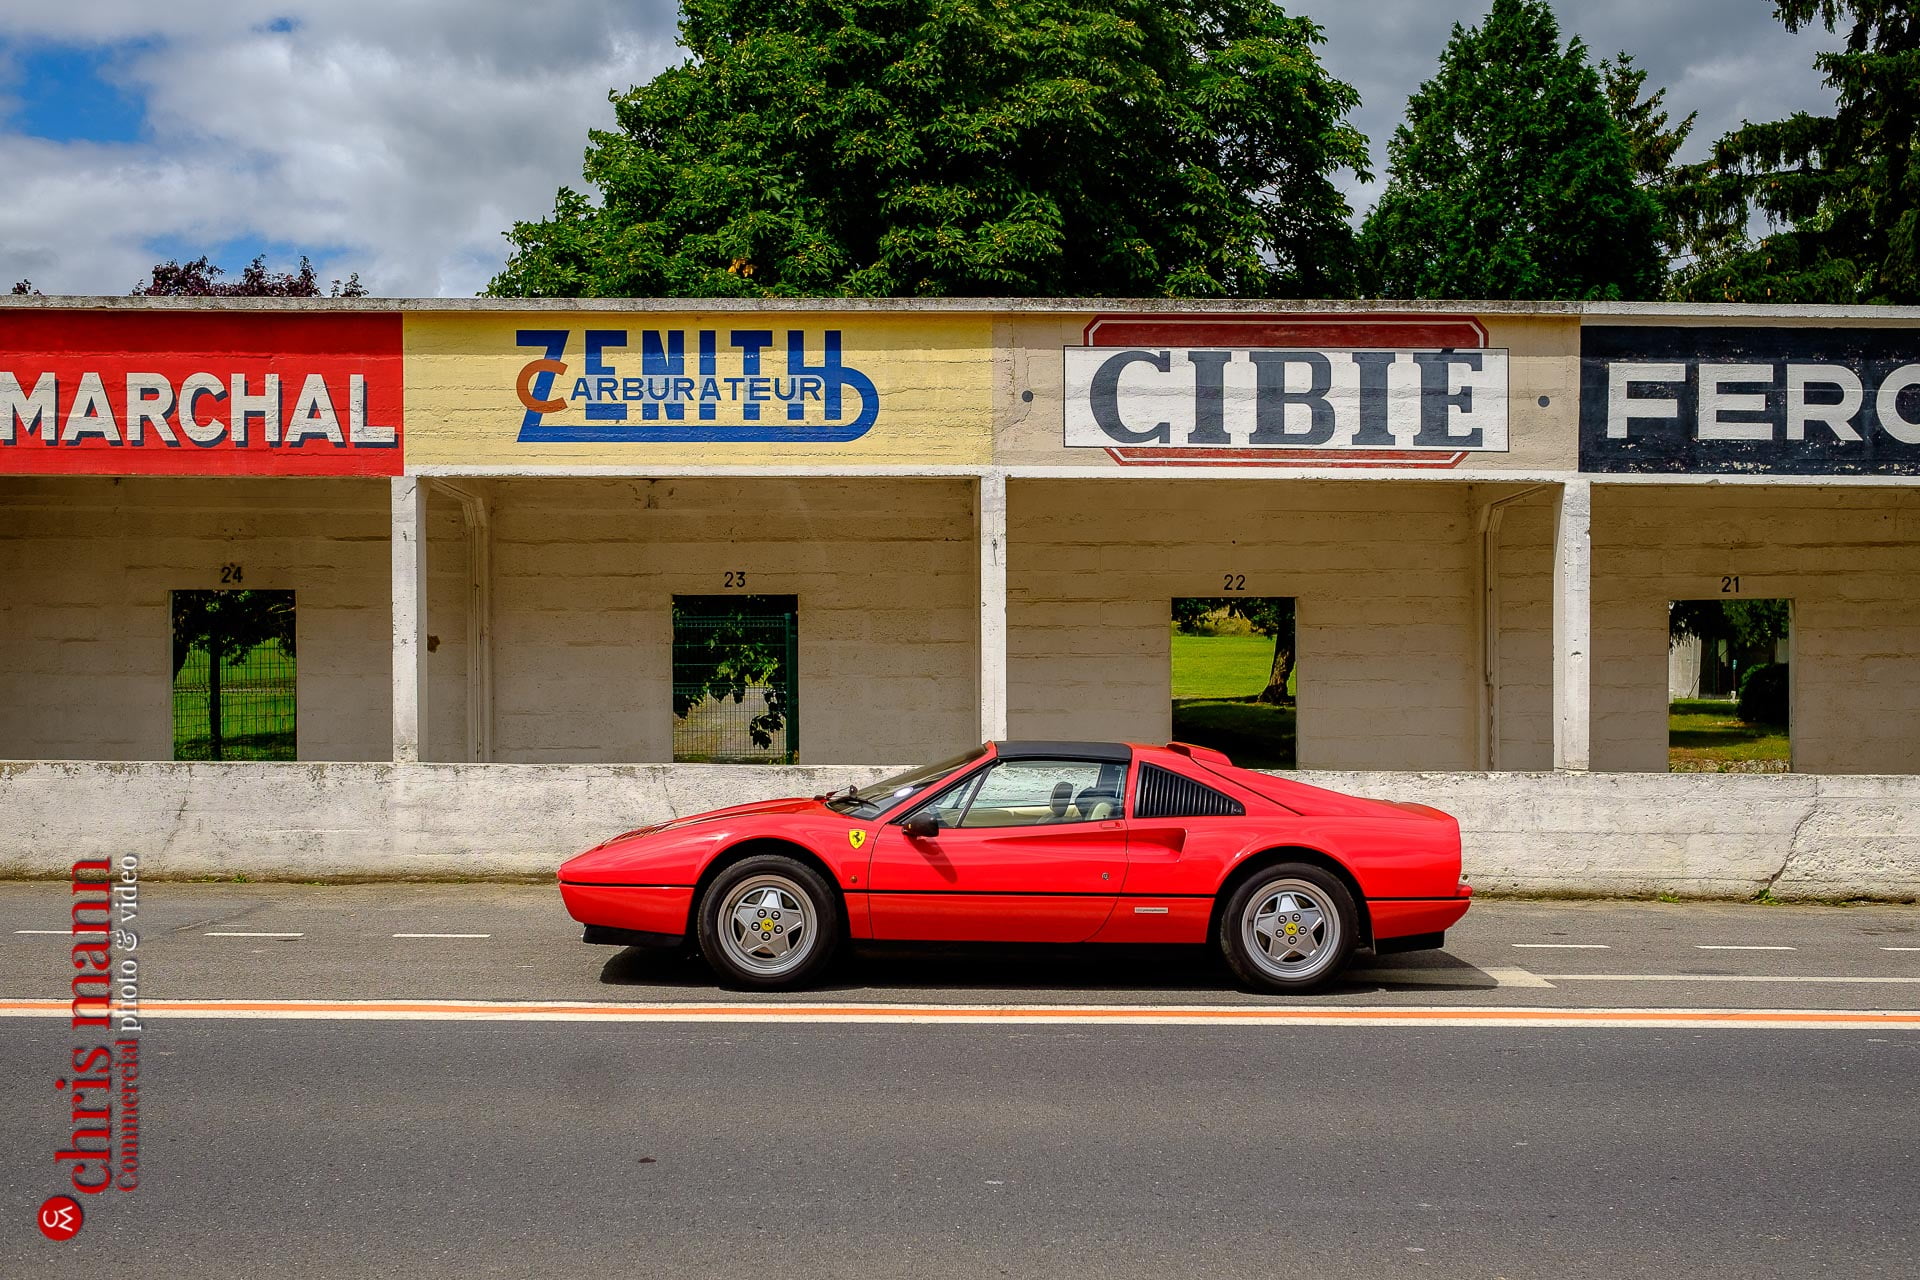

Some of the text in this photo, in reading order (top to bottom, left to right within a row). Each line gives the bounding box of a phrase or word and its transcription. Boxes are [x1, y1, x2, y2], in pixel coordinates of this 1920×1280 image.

[516, 330, 880, 443] ZENITH
[516, 359, 824, 414] CARBURATEUR
[1089, 347, 1484, 447] CIBIÉ
[0, 371, 398, 448] MARCHAL
[221, 566, 243, 583] 24
[724, 571, 746, 588] 23
[1224, 574, 1246, 591] 22
[1721, 576, 1740, 593] 21
